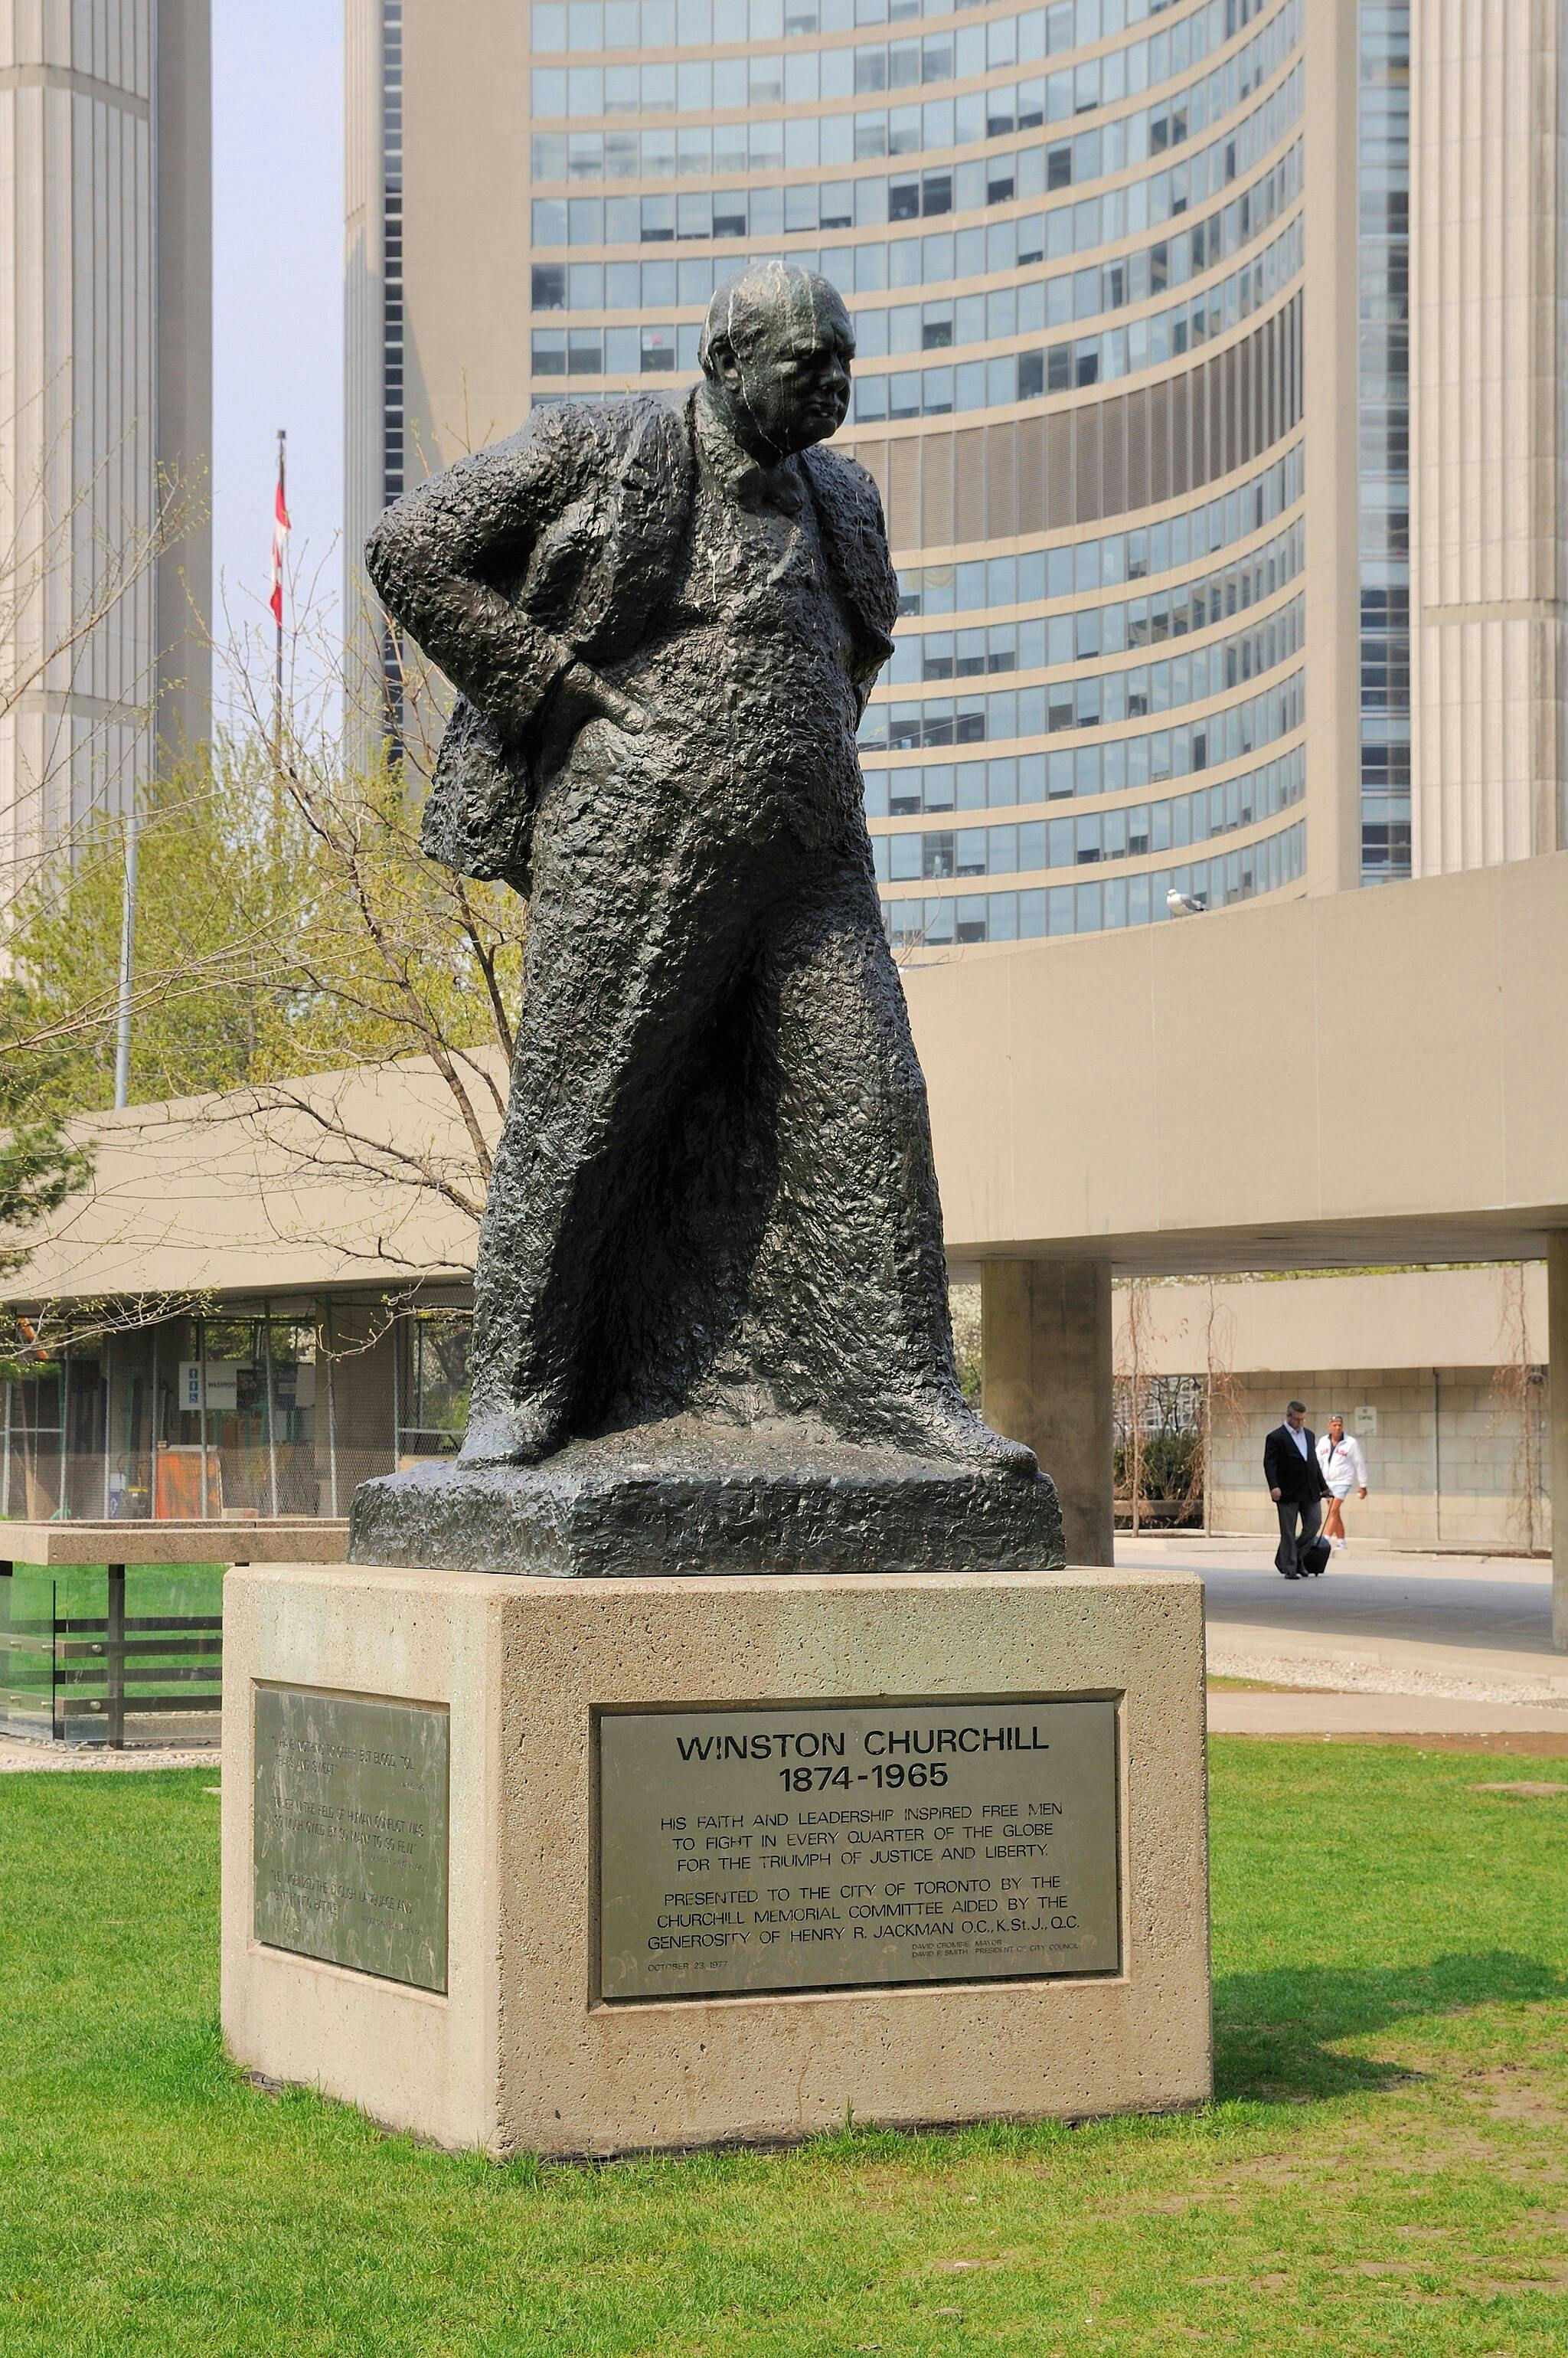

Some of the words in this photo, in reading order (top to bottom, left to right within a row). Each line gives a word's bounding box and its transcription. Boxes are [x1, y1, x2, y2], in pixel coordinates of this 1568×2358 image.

[676, 1732, 845, 1761] WINSTON
[864, 1726, 1050, 1755] CHURCHILL
[779, 1762, 949, 1792] 1874-1965
[661, 1816, 687, 1831] HIS
[697, 1814, 744, 1830] FAITH
[752, 1813, 789, 1827] AND
[799, 1808, 894, 1826] LEADERSHIP
[904, 1805, 972, 1821] INSPIRED
[982, 1804, 1018, 1818] FREE
[1028, 1802, 1063, 1817] MEN
[672, 1837, 695, 1851] TO
[706, 1835, 753, 1850] FIGHT
[761, 1834, 776, 1848] IN
[786, 1831, 840, 1846] EVERY
[847, 1828, 924, 1844] QUARTER
[933, 1827, 954, 1840] OF
[962, 1825, 993, 1840] THE
[1002, 1823, 1054, 1837] GLOBE
[677, 1858, 710, 1872] FOR
[717, 1856, 751, 1870] THE
[758, 1853, 831, 1869] TRIUMPH
[841, 1851, 862, 1865] OF
[870, 1848, 933, 1864] JUSTICE
[940, 1846, 976, 1861] AND
[985, 1843, 1048, 1859] LIBERTY.
[665, 1889, 759, 1906] PRESENTED
[766, 1888, 790, 1902] TO
[797, 1886, 831, 1900] THE
[840, 1884, 877, 1899] CITY
[884, 1882, 905, 1896] OF
[913, 1879, 991, 1895] TORONTO
[1001, 1877, 1023, 1891] BY
[1030, 1876, 1061, 1889] THE
[657, 1911, 745, 1928] CHURCHILL
[754, 1906, 841, 1923] MEMORIAL
[848, 1902, 943, 1918] COMMITTEE
[951, 1899, 998, 1914] AIDED
[1008, 1897, 1030, 1911] BY
[1037, 1895, 1068, 1908] THE
[648, 1931, 750, 1950] GENEROSITY
[759, 1931, 780, 1944] OF
[790, 1927, 846, 1943] HENRY
[854, 1926, 867, 1939] R.
[874, 1921, 954, 1939] JACKMAN
[936, 1941, 969, 1949] CROMBIE
[975, 1946, 1014, 1954] PRESIDENT
[1029, 1944, 1046, 1952] CITY
[1048, 1942, 1080, 1951] COUNCIL
[648, 1962, 689, 1972] OCTOBER
[709, 1961, 728, 1970] 1977
